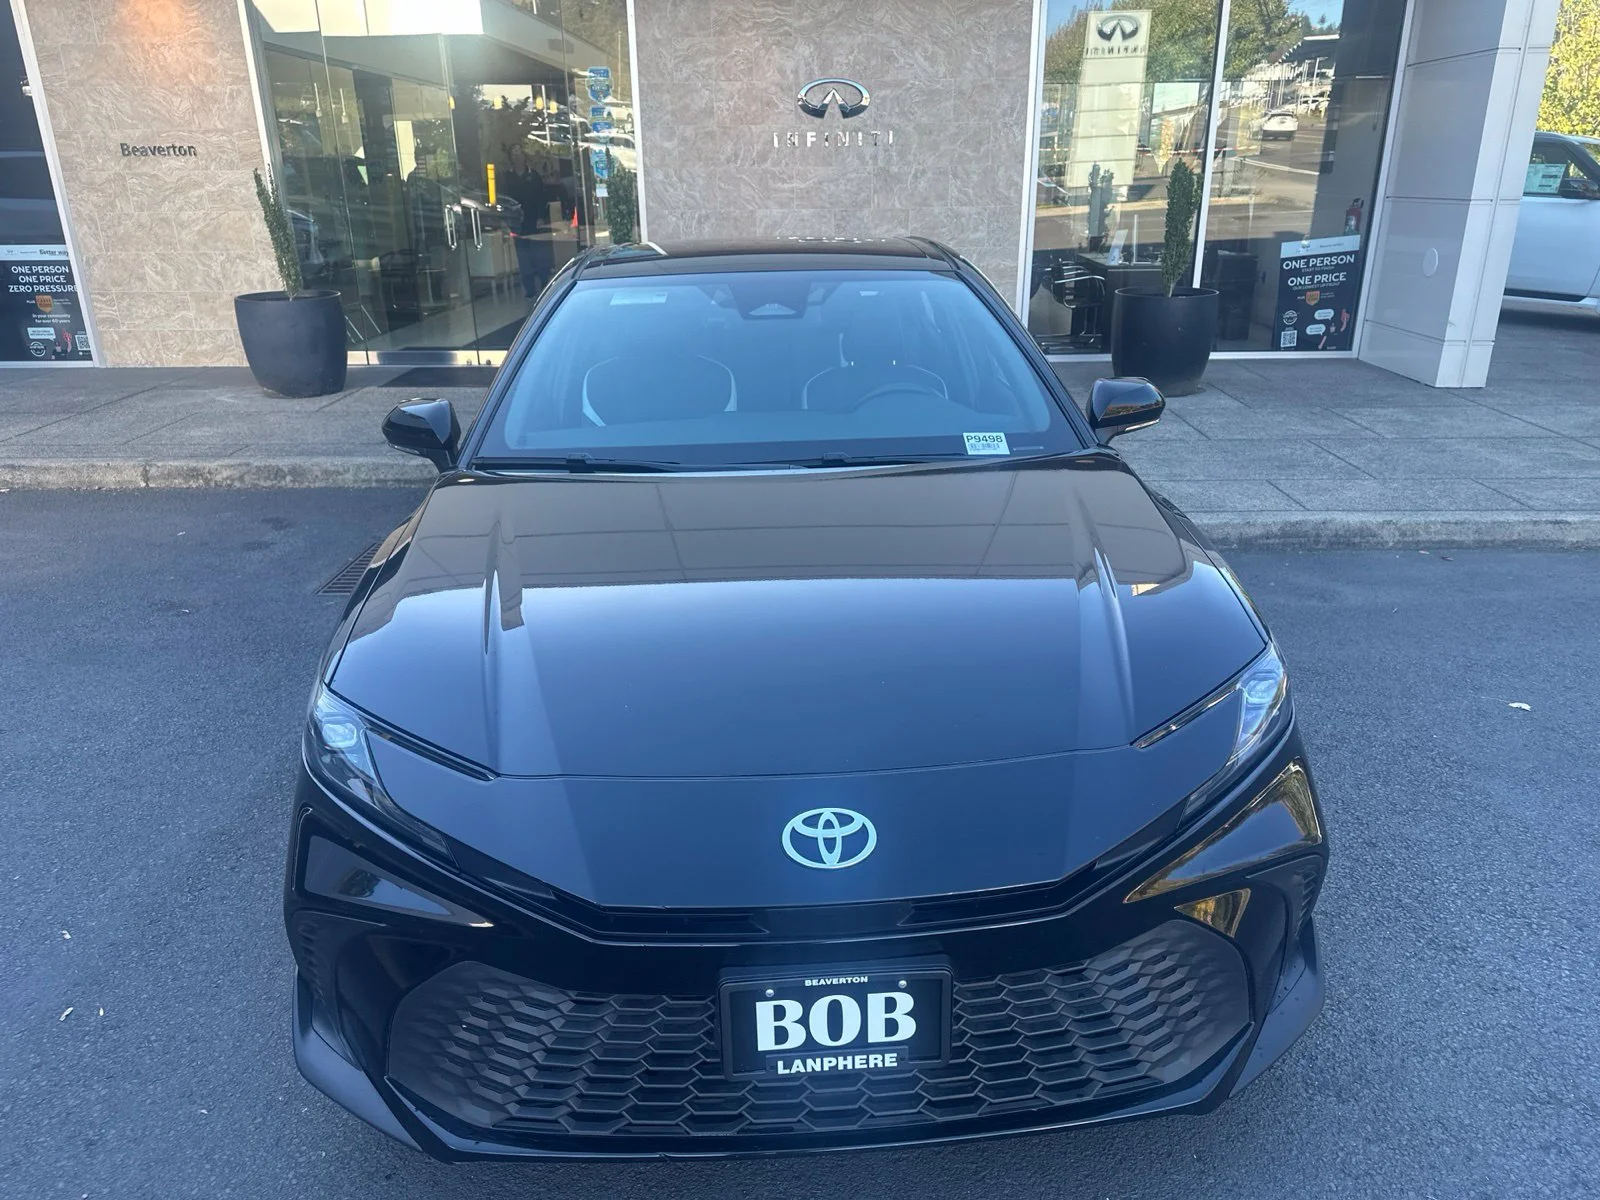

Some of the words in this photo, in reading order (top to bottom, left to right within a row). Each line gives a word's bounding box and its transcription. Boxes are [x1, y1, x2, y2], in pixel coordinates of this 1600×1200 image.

[773, 130, 894, 148] INFINITI
[119, 142, 198, 157] Beaverton
[11, 265, 31, 274] ONE
[32, 265, 69, 274] PERSON
[1282, 259, 1308, 270] ONE
[1309, 254, 1355, 268] PERSON
[18, 275, 38, 283] ONE
[40, 275, 66, 283] PRICE
[1287, 275, 1312, 287] ONE
[1313, 272, 1347, 284] PRICE
[8, 284, 33, 293] ZERO
[965, 434, 1004, 443] P9498
[804, 975, 869, 987] BEAVERTON
[755, 991, 917, 1052] BOB
[777, 1052, 898, 1075] LANPHERE
